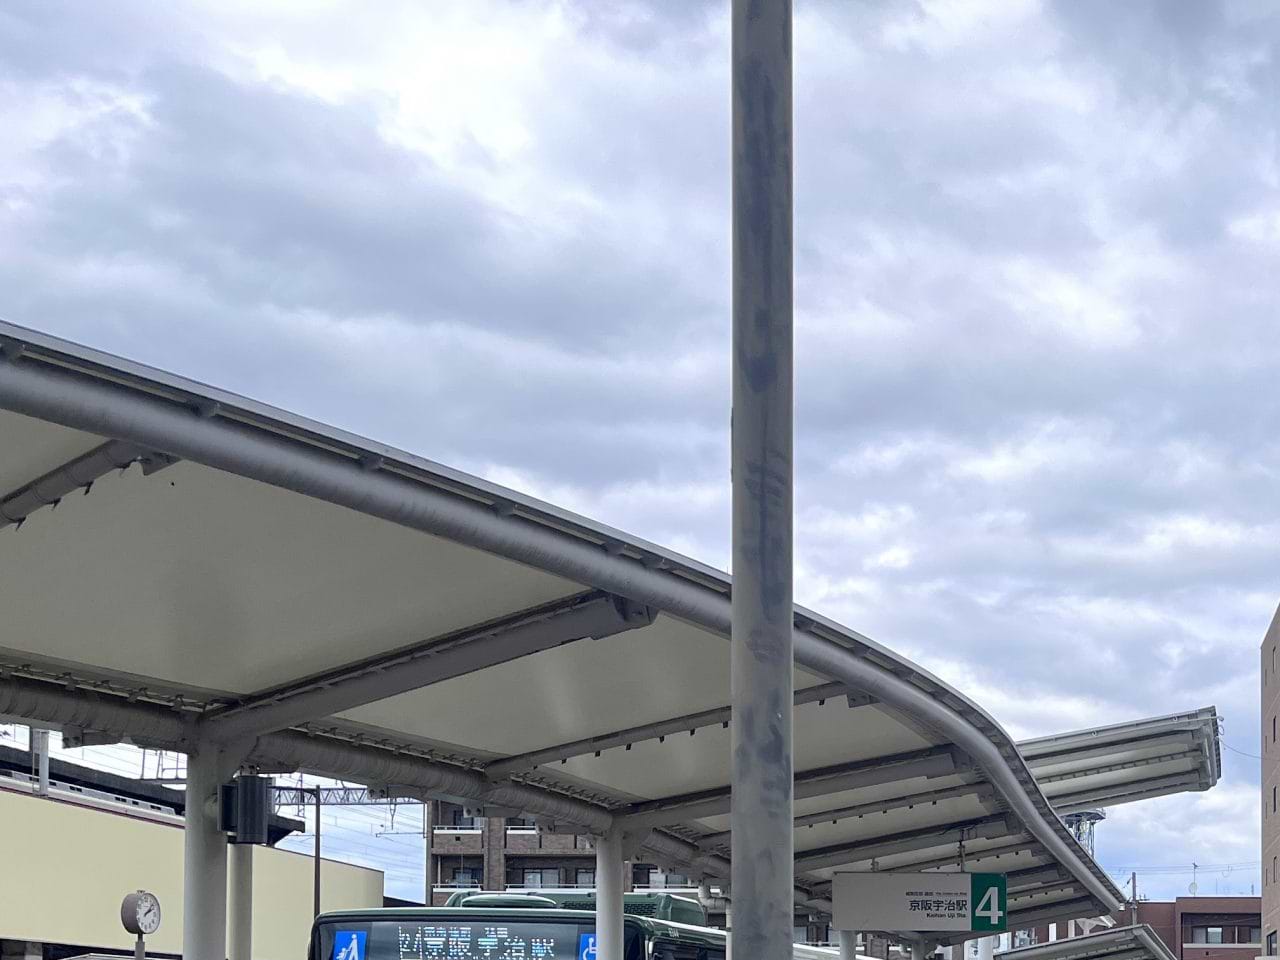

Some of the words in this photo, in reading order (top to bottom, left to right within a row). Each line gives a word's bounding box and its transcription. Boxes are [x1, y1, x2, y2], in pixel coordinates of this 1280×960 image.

[908, 900, 968, 911] 京阪宇治駅
[975, 886, 1003, 925] 4
